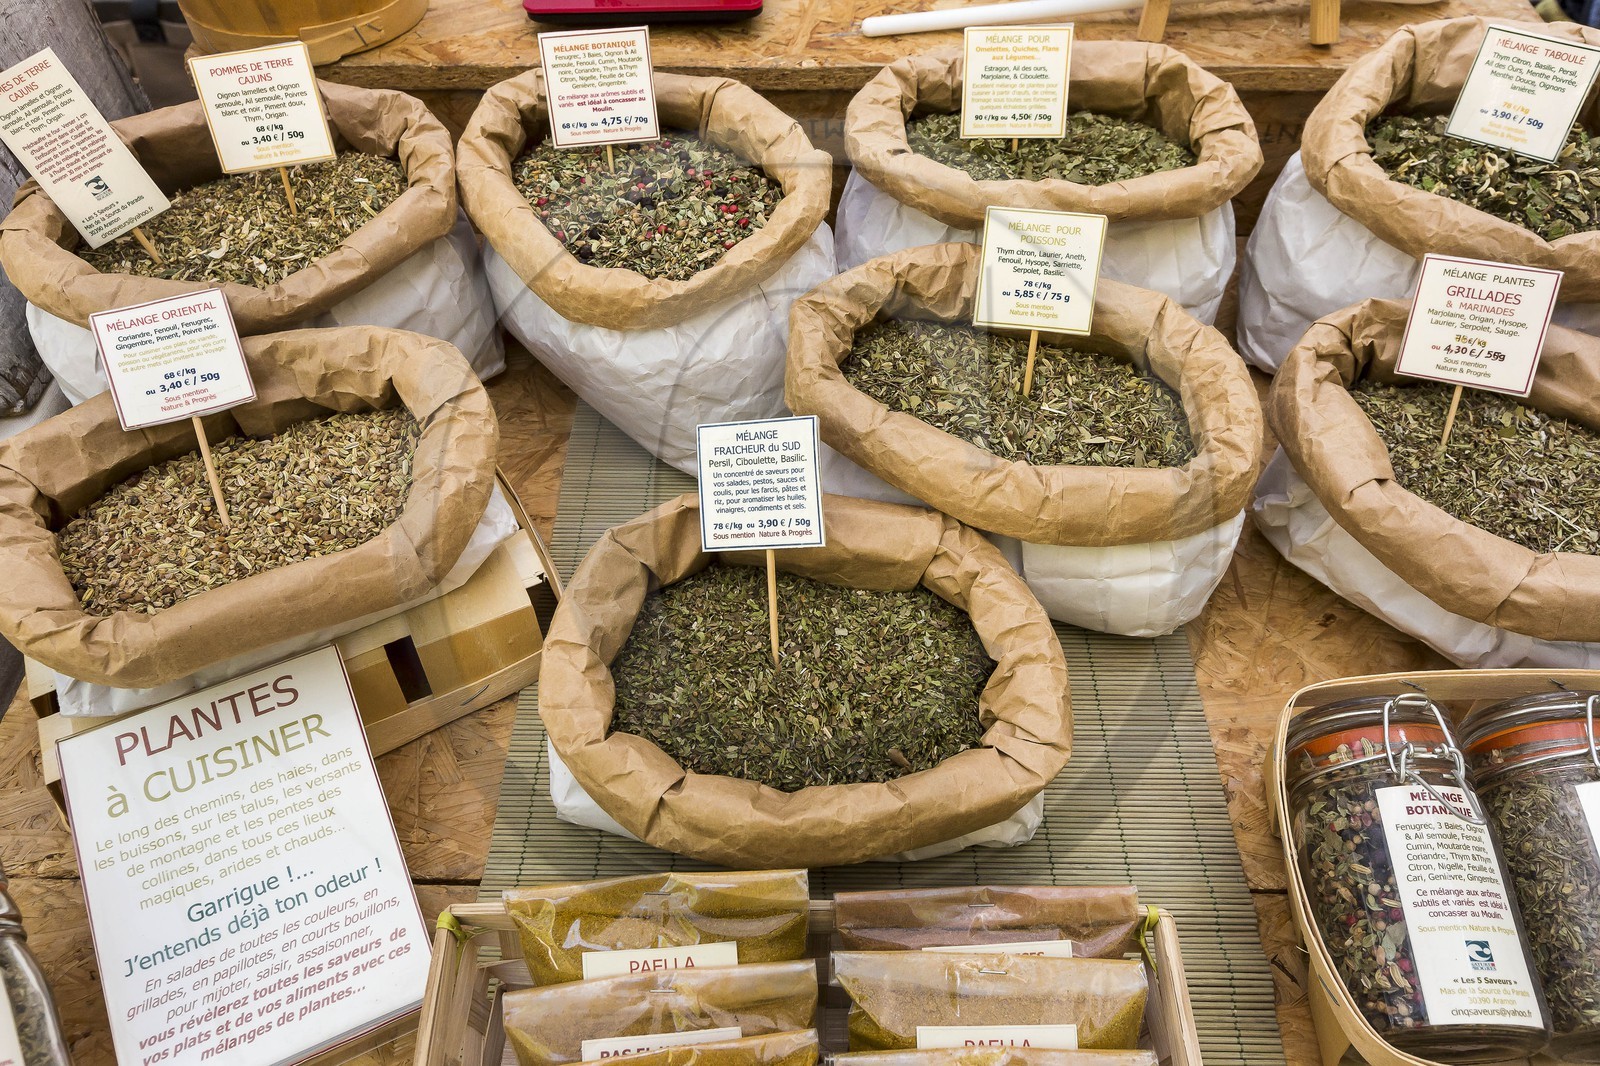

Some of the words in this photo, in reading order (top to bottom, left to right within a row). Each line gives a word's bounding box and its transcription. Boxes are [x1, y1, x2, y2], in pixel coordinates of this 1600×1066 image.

[553, 43, 590, 53] MÉLANGE
[591, 40, 636, 50] BOTANIQUE
[985, 34, 1023, 44] MÉLANGE
[1028, 35, 1051, 43] POUR
[1497, 38, 1540, 55] MÉLANGE
[1544, 48, 1586, 66] TABOULÉ
[209, 63, 249, 77] POMMES
[249, 61, 263, 72] DE
[263, 57, 294, 69] TERRE
[984, 65, 1011, 73] Estragon,
[1493, 51, 1511, 61] Thym
[1511, 56, 1532, 68] Citron,
[1534, 61, 1556, 73] Basilic,
[1558, 67, 1578, 78] Persil,
[238, 72, 273, 86] CAJUNS
[980, 73, 1012, 81] Marjolaine,
[1490, 69, 1514, 81] Menthe
[1514, 75, 1537, 87] Douce,
[1538, 81, 1566, 93] Oignons
[8, 81, 39, 103] CAJUNS
[1510, 83, 1536, 95] lanières.
[214, 99, 244, 109] semoule,
[245, 97, 254, 105] Ail
[254, 93, 284, 104] semoule,
[284, 91, 308, 99] Poivres
[252, 134, 272, 145] 3,40
[287, 130, 305, 139] 50g
[1007, 220, 1051, 234] MÉLANGE
[1056, 225, 1082, 236] POUR
[1020, 234, 1067, 247] POISSONS
[996, 246, 1015, 256] Thym
[1016, 249, 1037, 258] citron,
[1038, 250, 1063, 260] Laurier,
[1064, 253, 1087, 262] Aneth,
[1012, 265, 1042, 276] Serpolet,
[1043, 268, 1065, 277] Basilic.
[1442, 267, 1488, 282] MÉLANGE
[1492, 274, 1536, 288] PLANTES
[1023, 280, 1034, 288] 78
[1446, 285, 1522, 305] GRILLADES
[106, 313, 160, 332] MÉLANGE
[161, 301, 217, 320] ORIENTAL
[1459, 302, 1515, 317] MARINADES
[1427, 308, 1466, 321] Marjolaine,
[1468, 313, 1496, 325] Origan,
[1498, 318, 1528, 330] Hysope,
[1430, 318, 1457, 329] Laurier,
[1459, 321, 1492, 334] Serpolet,
[1494, 326, 1520, 337] Sauge.
[115, 339, 155, 351] Gingembre,
[155, 332, 181, 342] Piment,
[181, 327, 203, 336] Poivre
[203, 323, 220, 331] Noir.
[117, 331, 153, 343] Coriandre,
[153, 323, 180, 335] Fenouil,
[180, 317, 213, 329] Fenugrec,
[159, 380, 183, 393] 3,40
[200, 372, 220, 383] 50g
[736, 429, 778, 442] MÉLANGE
[714, 443, 766, 456] FRAICHEUR
[768, 442, 780, 453] du
[781, 441, 801, 452] SUD
[708, 458, 733, 468] Persil,
[735, 456, 778, 466] Ciboulette,
[780, 453, 807, 463] Basilic.
[713, 522, 724, 530] 78
[758, 518, 779, 529] 3,90
[795, 518, 811, 527] 50g
[114, 675, 299, 766] PLANTES
[143, 713, 332, 802] CUISINER
[96, 839, 114, 853] Le
[118, 825, 150, 844] long
[154, 814, 180, 831] des
[183, 790, 245, 820] chemins,
[249, 778, 274, 794] des
[277, 763, 317, 783] haies,
[321, 747, 353, 766] dans
[1410, 789, 1464, 803] MÉLNGE
[187, 876, 280, 922] Garrigue
[227, 903, 270, 934] déjà
[274, 891, 308, 914] ton
[314, 865, 368, 898] odeur
[139, 1027, 175, 1050] vous
[179, 995, 250, 1033] révèlerez
[253, 973, 299, 1001] toutes
[303, 963, 324, 980] les
[327, 938, 382, 969] saveurs
[389, 927, 407, 942] de
[1484, 977, 1512, 985] Saveurs
